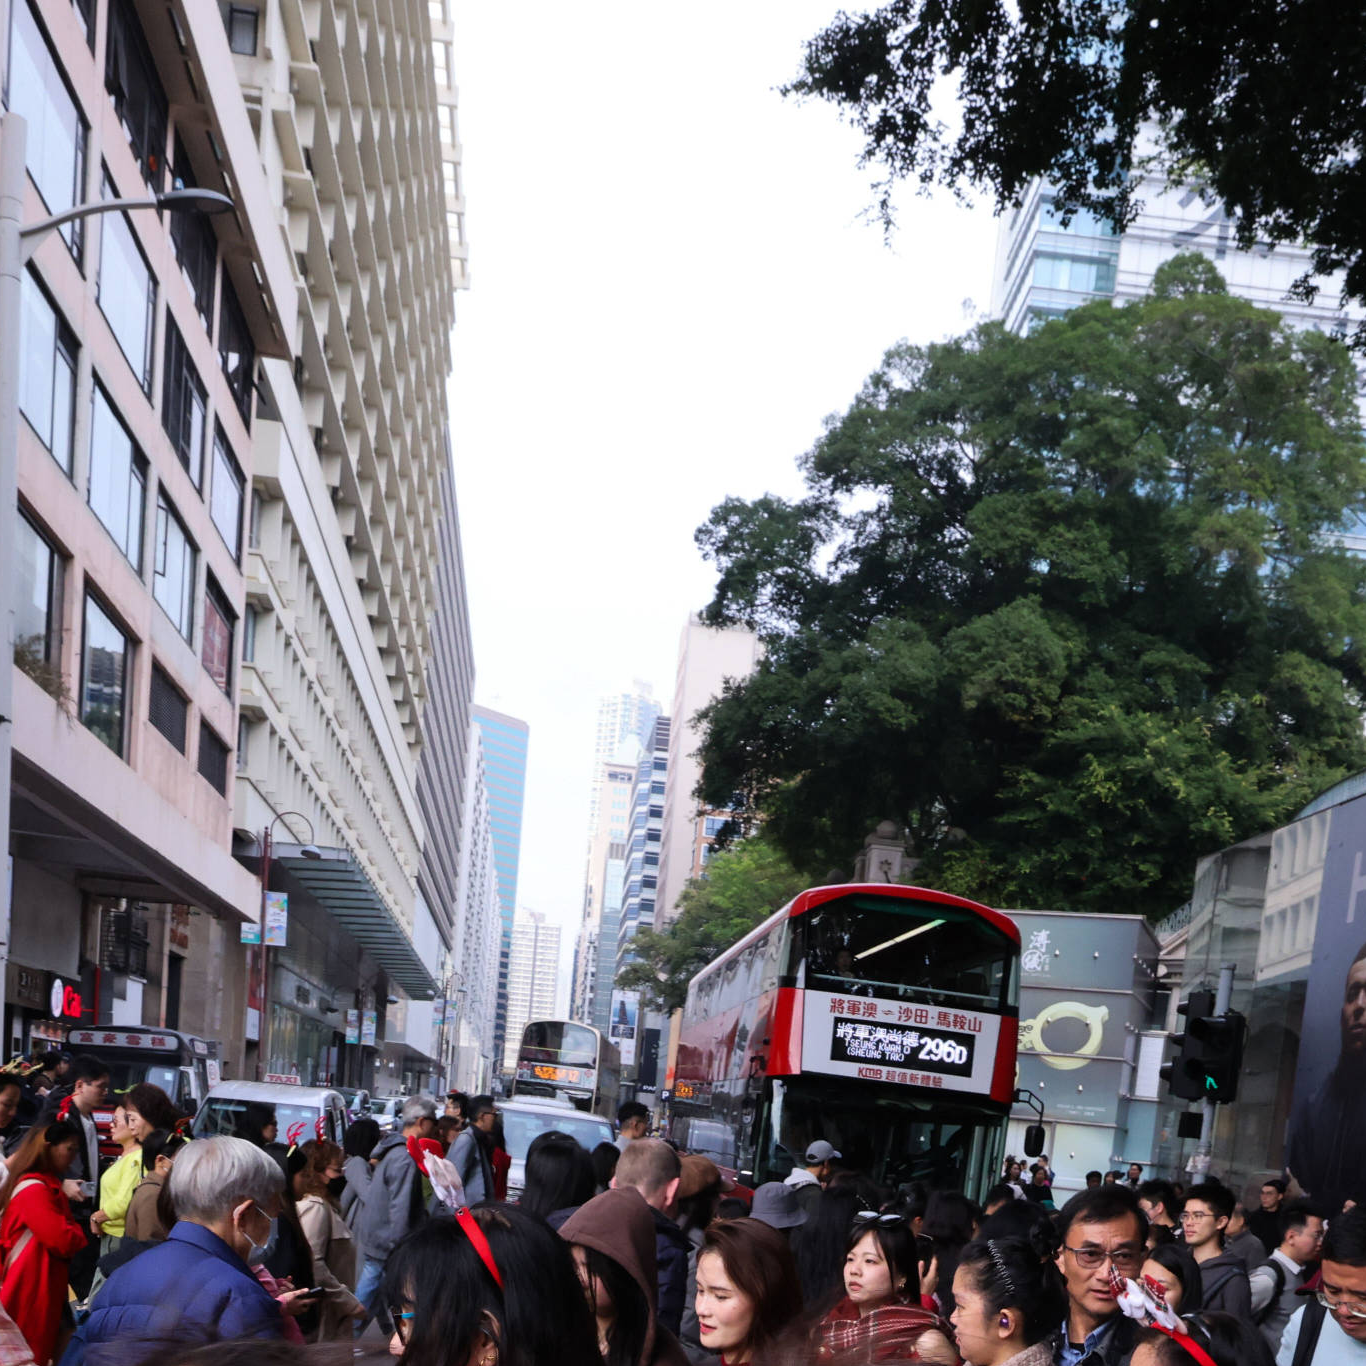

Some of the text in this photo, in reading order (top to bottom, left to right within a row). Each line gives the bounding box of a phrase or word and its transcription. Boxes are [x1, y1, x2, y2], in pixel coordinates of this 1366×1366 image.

[830, 998, 878, 1018] 將軍澳
[836, 1022, 920, 1047] 將軍澳尚德
[845, 1038, 877, 1051] TSEUNG
[878, 1041, 902, 1054] KWAN
[918, 1036, 968, 1065] 296D
[266, 1074, 298, 1084] TAXI
[857, 1067, 883, 1080] KMB
[661, 1090, 670, 1100] P
